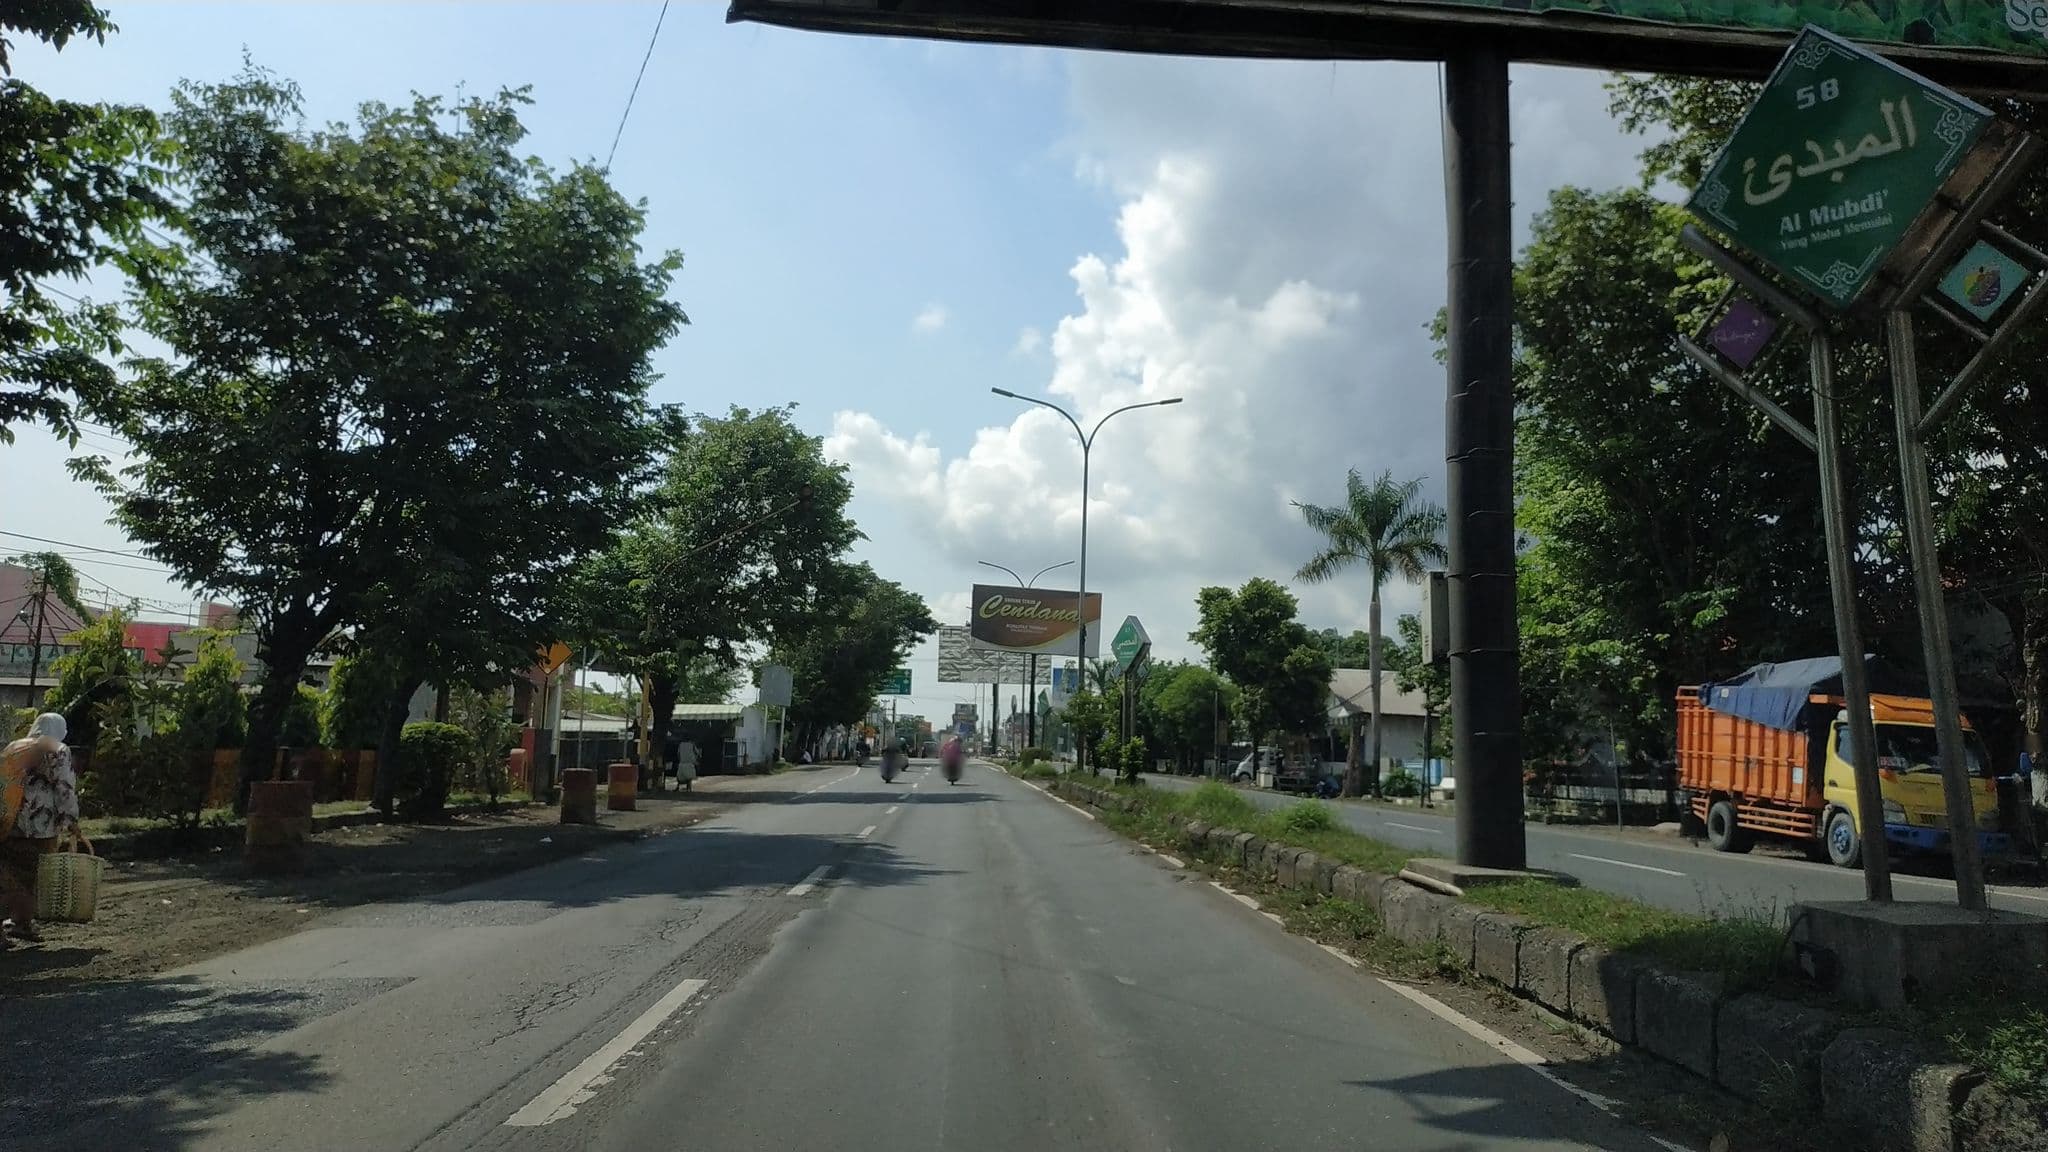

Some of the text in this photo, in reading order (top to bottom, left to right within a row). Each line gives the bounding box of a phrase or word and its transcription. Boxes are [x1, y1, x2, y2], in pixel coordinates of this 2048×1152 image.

[1795, 78, 1840, 110] 58
[1779, 213, 1802, 236] Al
[979, 594, 1080, 623] Cendana
